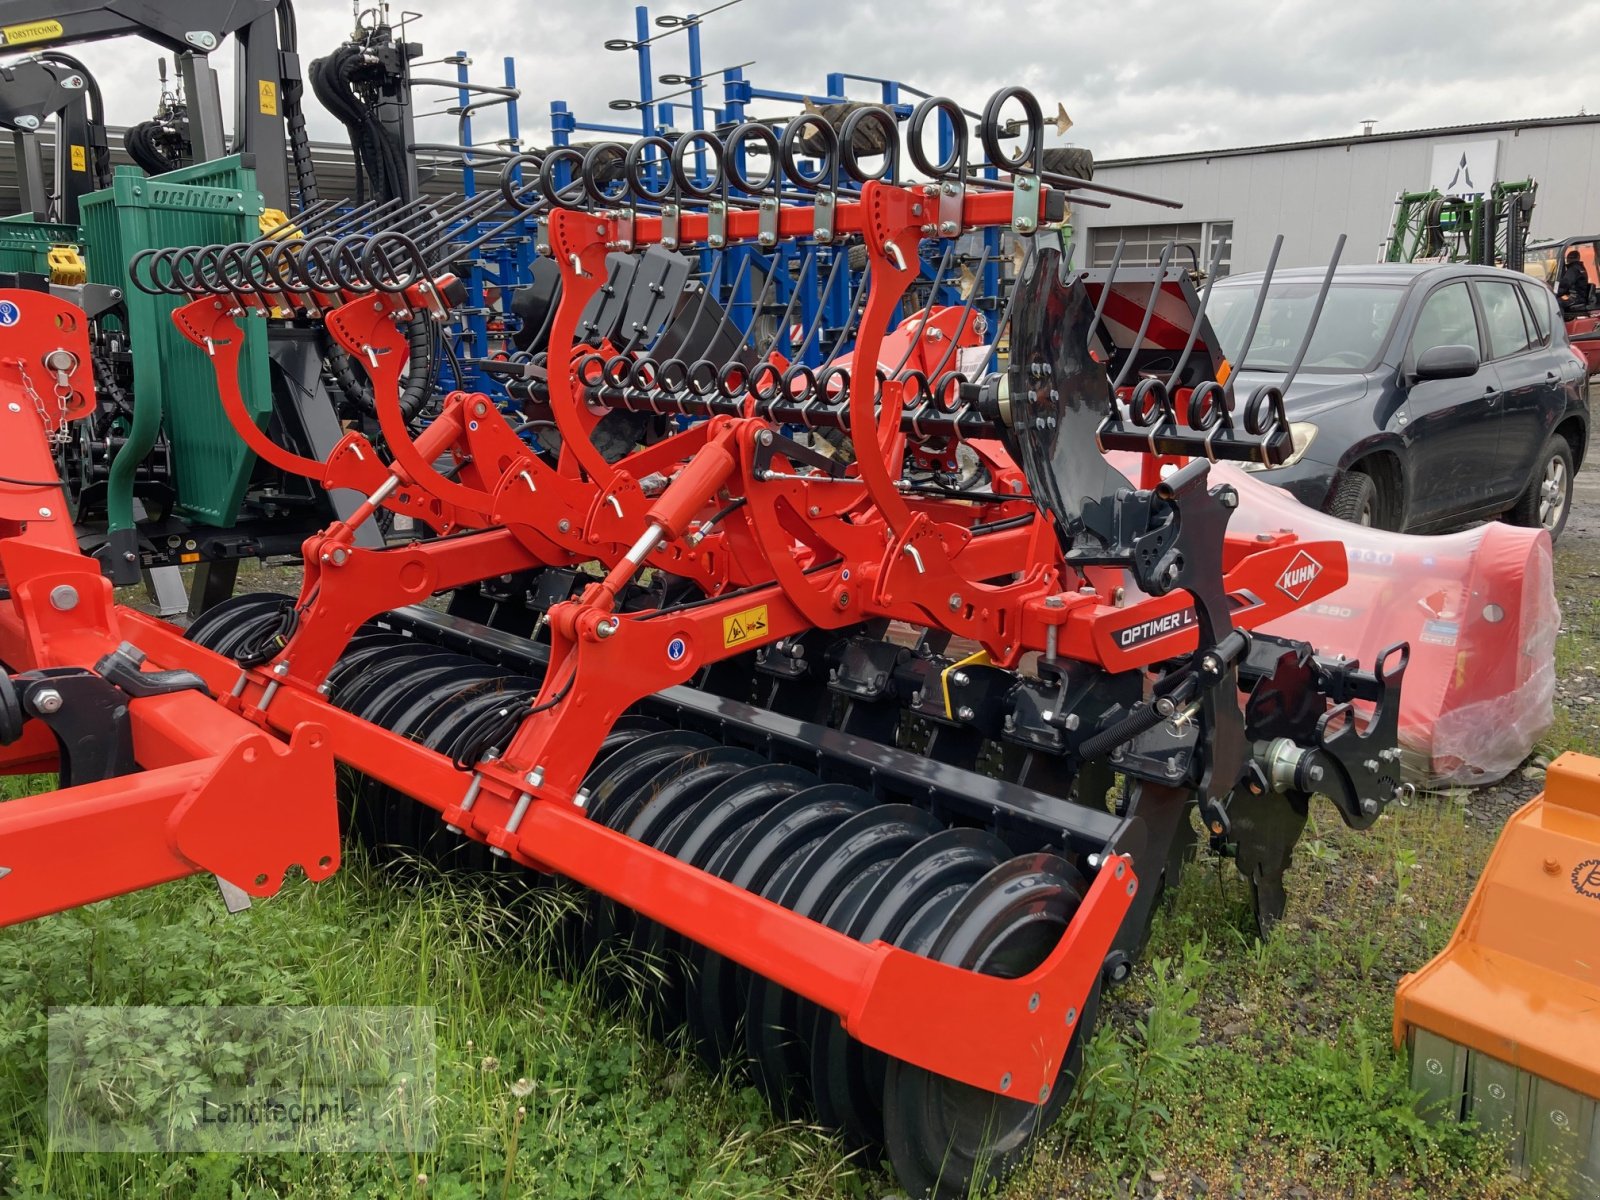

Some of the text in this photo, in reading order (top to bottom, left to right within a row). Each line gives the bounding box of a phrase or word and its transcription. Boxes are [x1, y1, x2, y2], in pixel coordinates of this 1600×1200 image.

[8, 25, 59, 39] FORSTTECHNIK
[1283, 563, 1315, 589] KUHN
[1121, 609, 1192, 646] OPTIMER L
